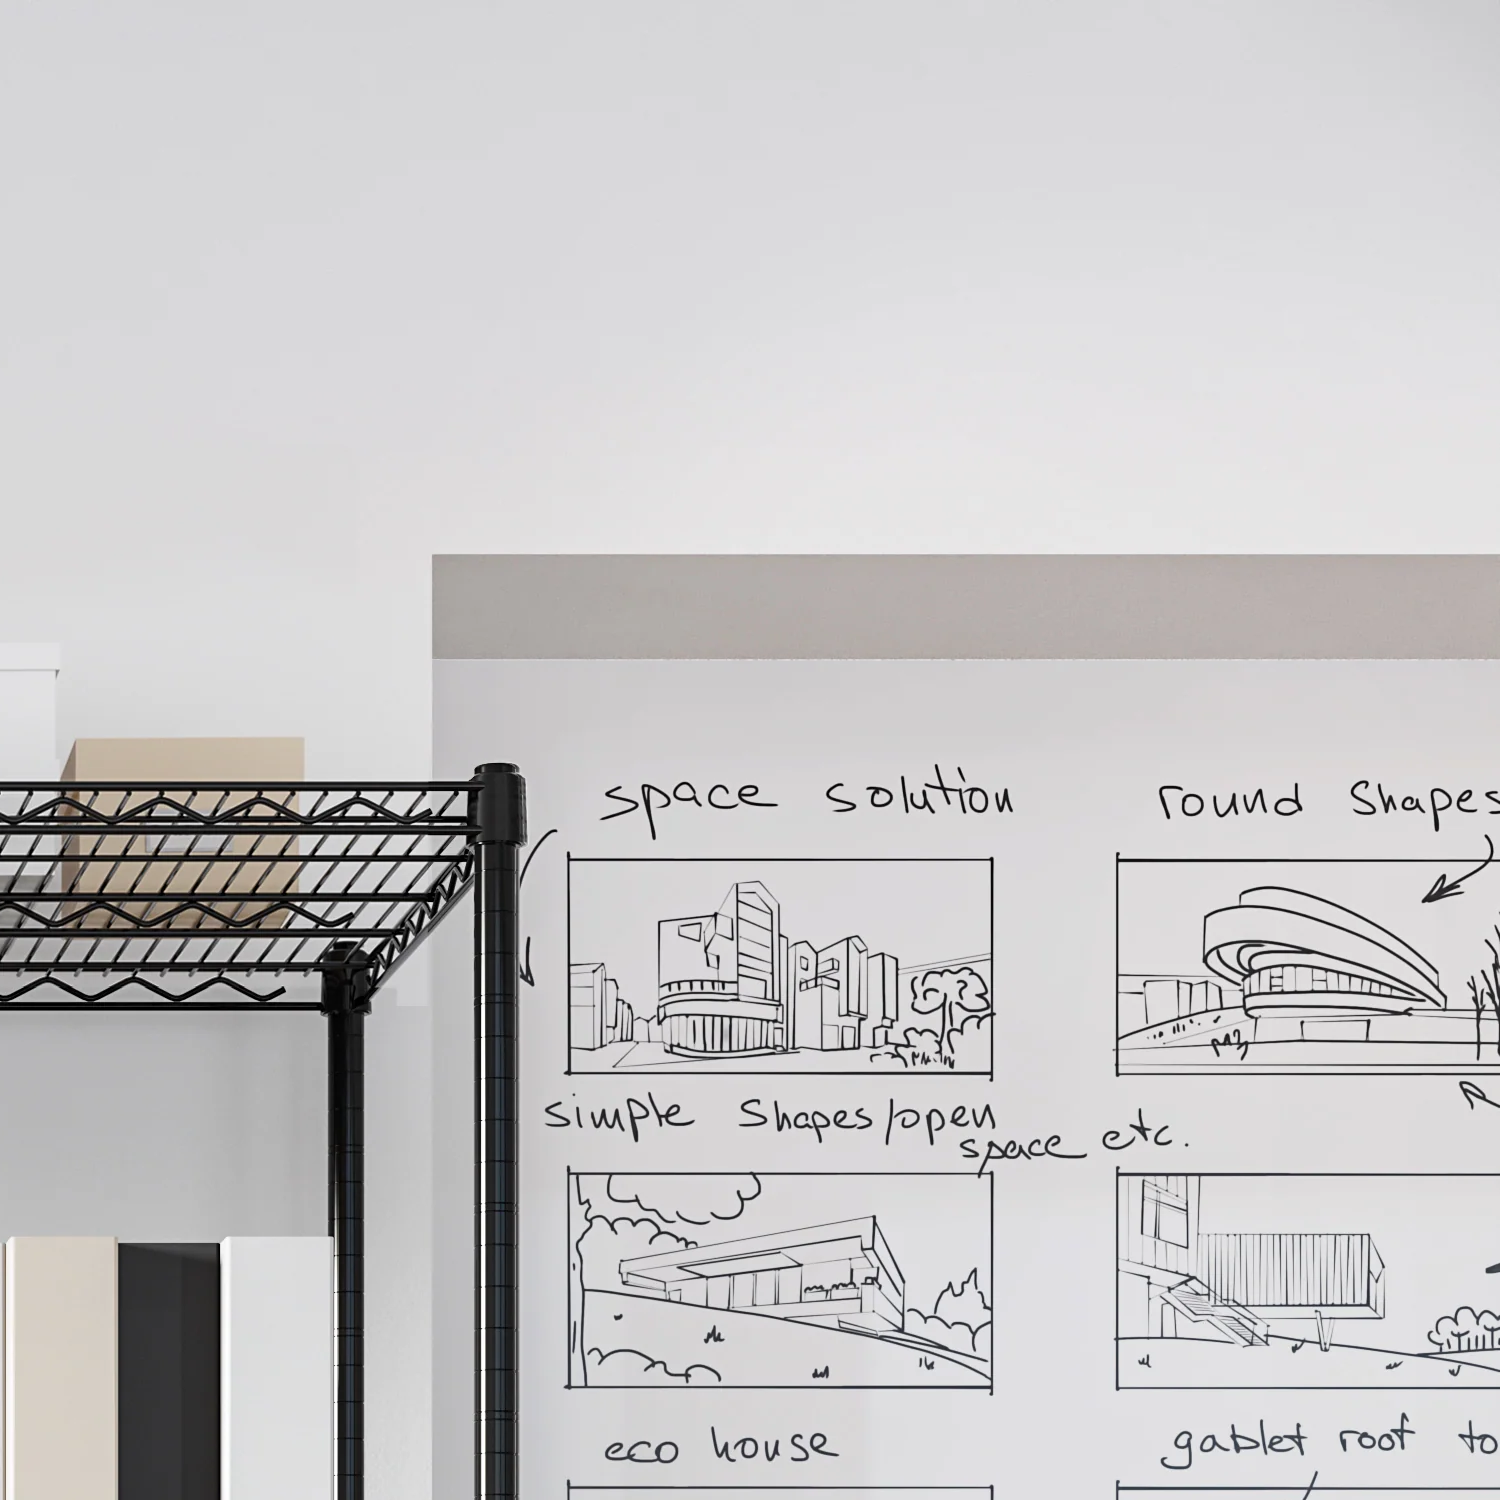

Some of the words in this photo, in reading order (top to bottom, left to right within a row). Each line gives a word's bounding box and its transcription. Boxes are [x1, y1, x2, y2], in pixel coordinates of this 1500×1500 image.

[599, 781, 779, 841] space
[825, 763, 1014, 815] solution
[1158, 782, 1304, 820] round
[544, 1091, 696, 1143] simple
[956, 1134, 1088, 1179] space
[1101, 1107, 1190, 1151] etc.
[604, 1440, 680, 1464] eco
[710, 1425, 840, 1463] house
[1338, 1411, 1416, 1453] roof
